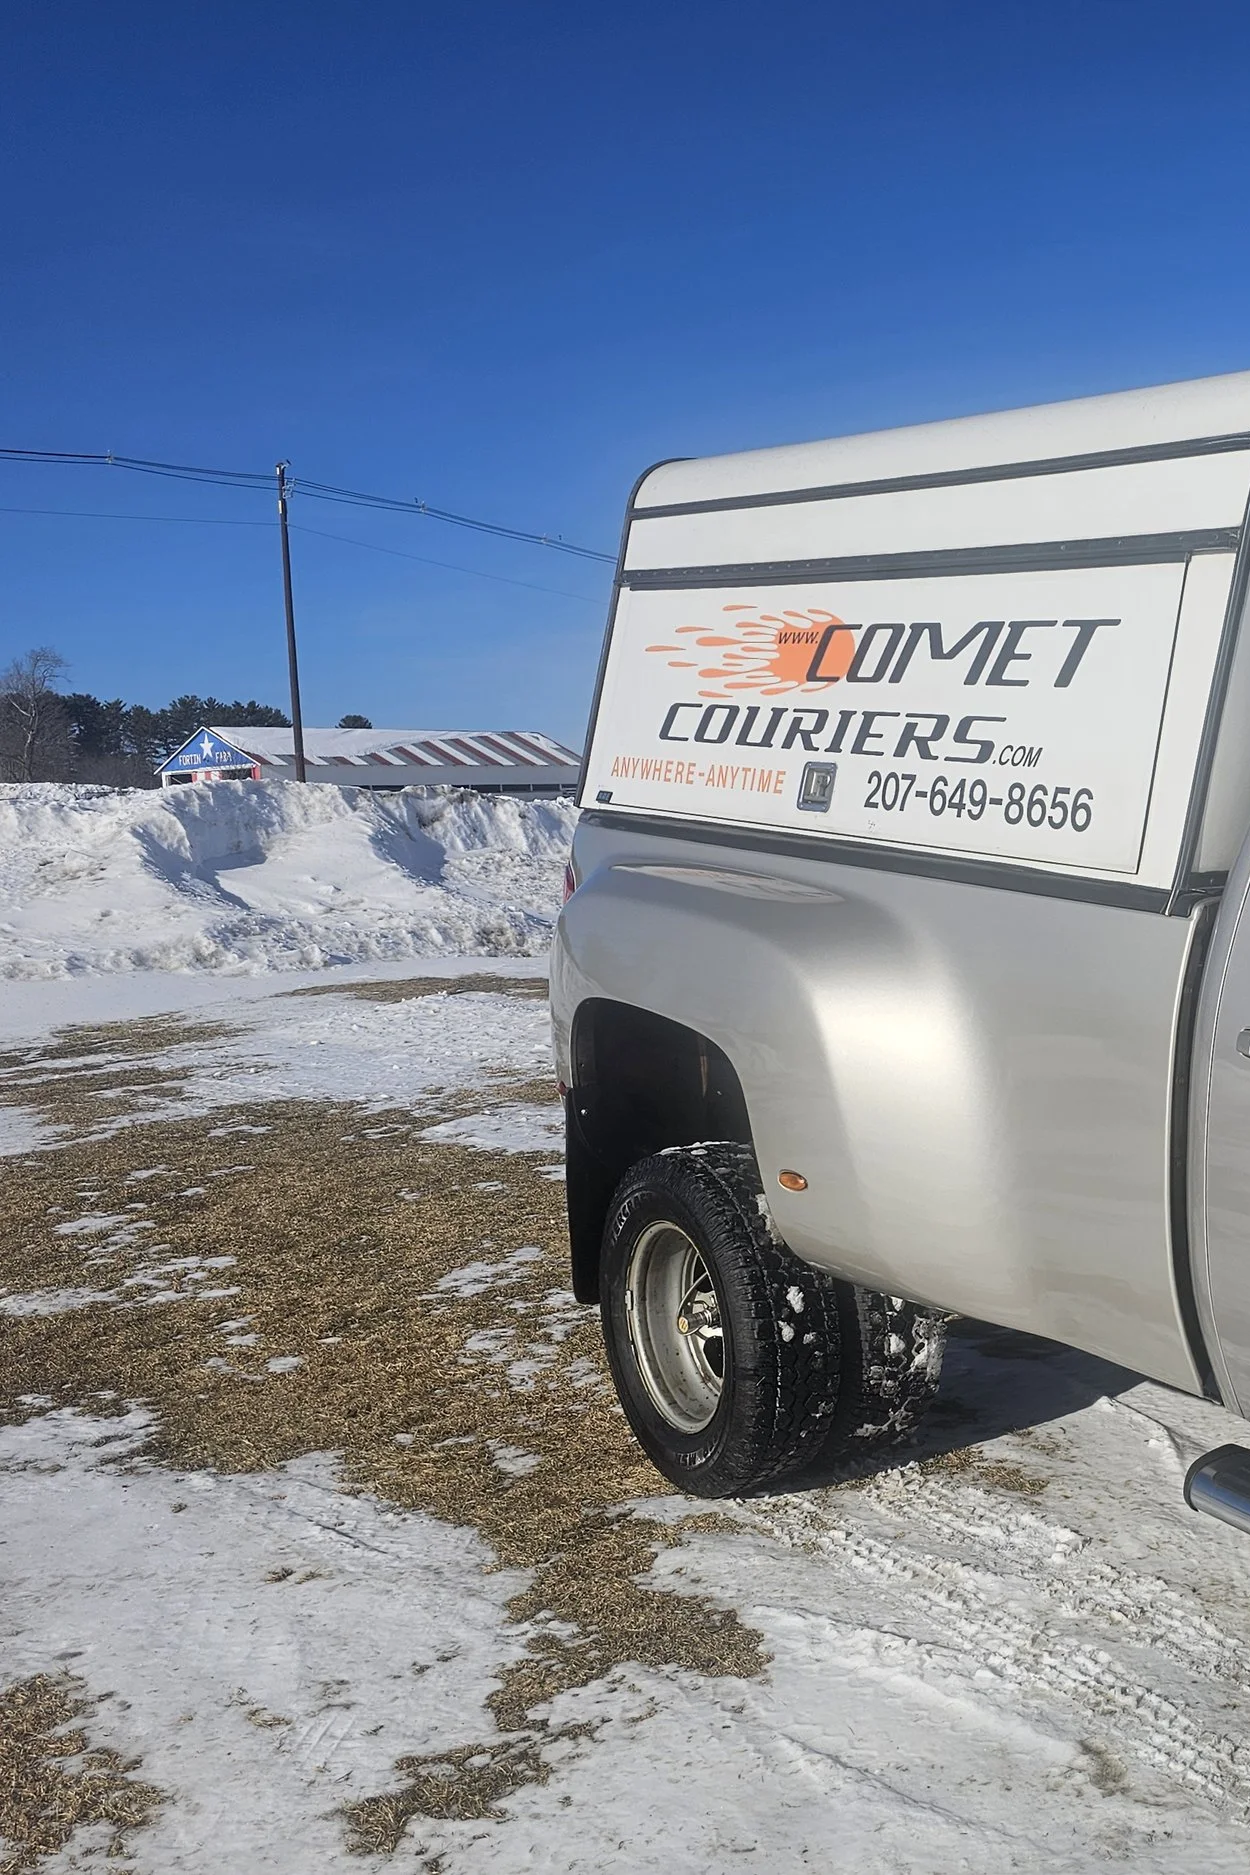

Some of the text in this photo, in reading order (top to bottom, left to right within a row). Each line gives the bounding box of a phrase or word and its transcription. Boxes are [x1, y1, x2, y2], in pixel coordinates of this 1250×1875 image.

[805, 618, 1122, 688] COMET
[658, 702, 1007, 764] COURIERS
[610, 756, 787, 795] ANYWHERE-ANYTIME
[863, 770, 1094, 833] 207-649-8656
